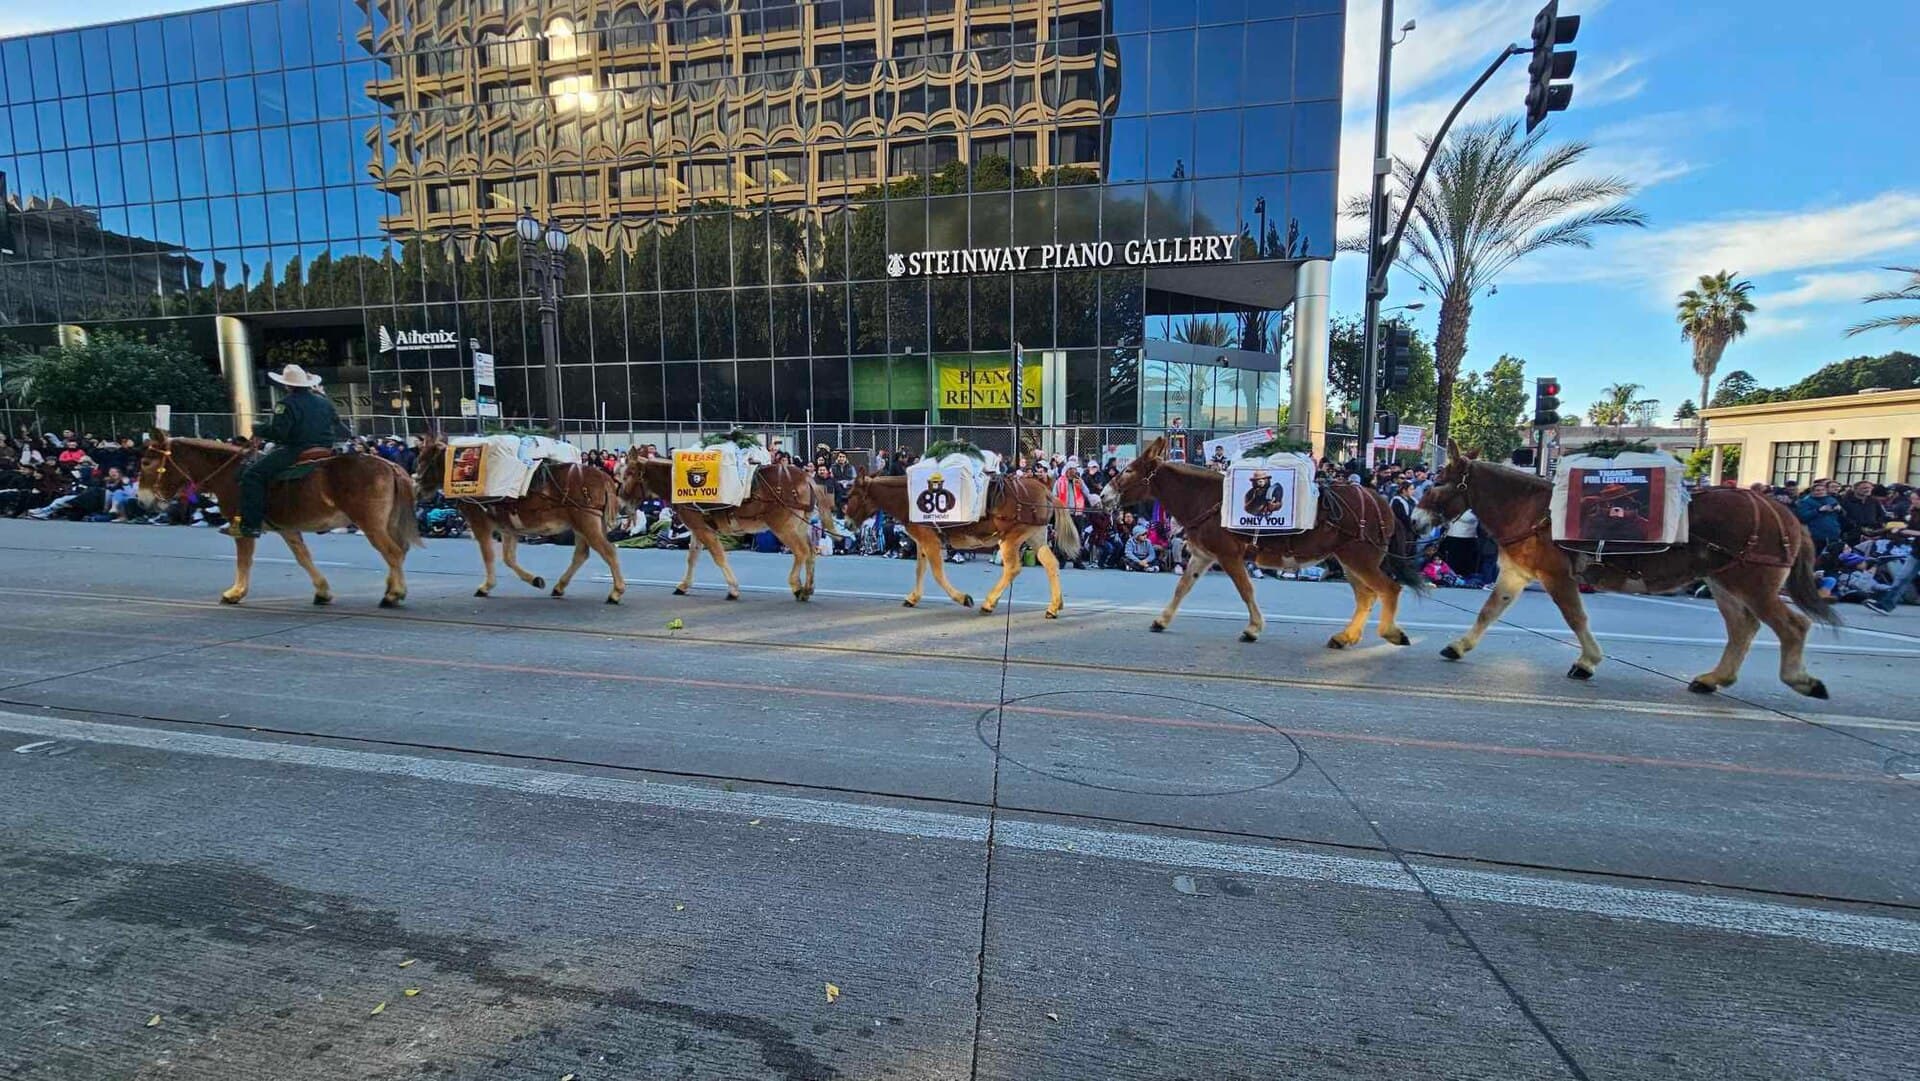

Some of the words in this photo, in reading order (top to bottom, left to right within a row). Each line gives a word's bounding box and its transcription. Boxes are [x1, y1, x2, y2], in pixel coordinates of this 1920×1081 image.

[908, 246, 1030, 276] STEINWAY
[1041, 241, 1113, 270] PIANO
[1124, 234, 1238, 266] GALLERY
[396, 329, 460, 345] Athenix
[946, 388, 1036, 405] RENTAS
[681, 453, 717, 462] PLEASE
[701, 488, 717, 496] YOU
[919, 491, 952, 513] 80
[1239, 517, 1262, 526] ONLY
[1264, 516, 1285, 526] YOU
